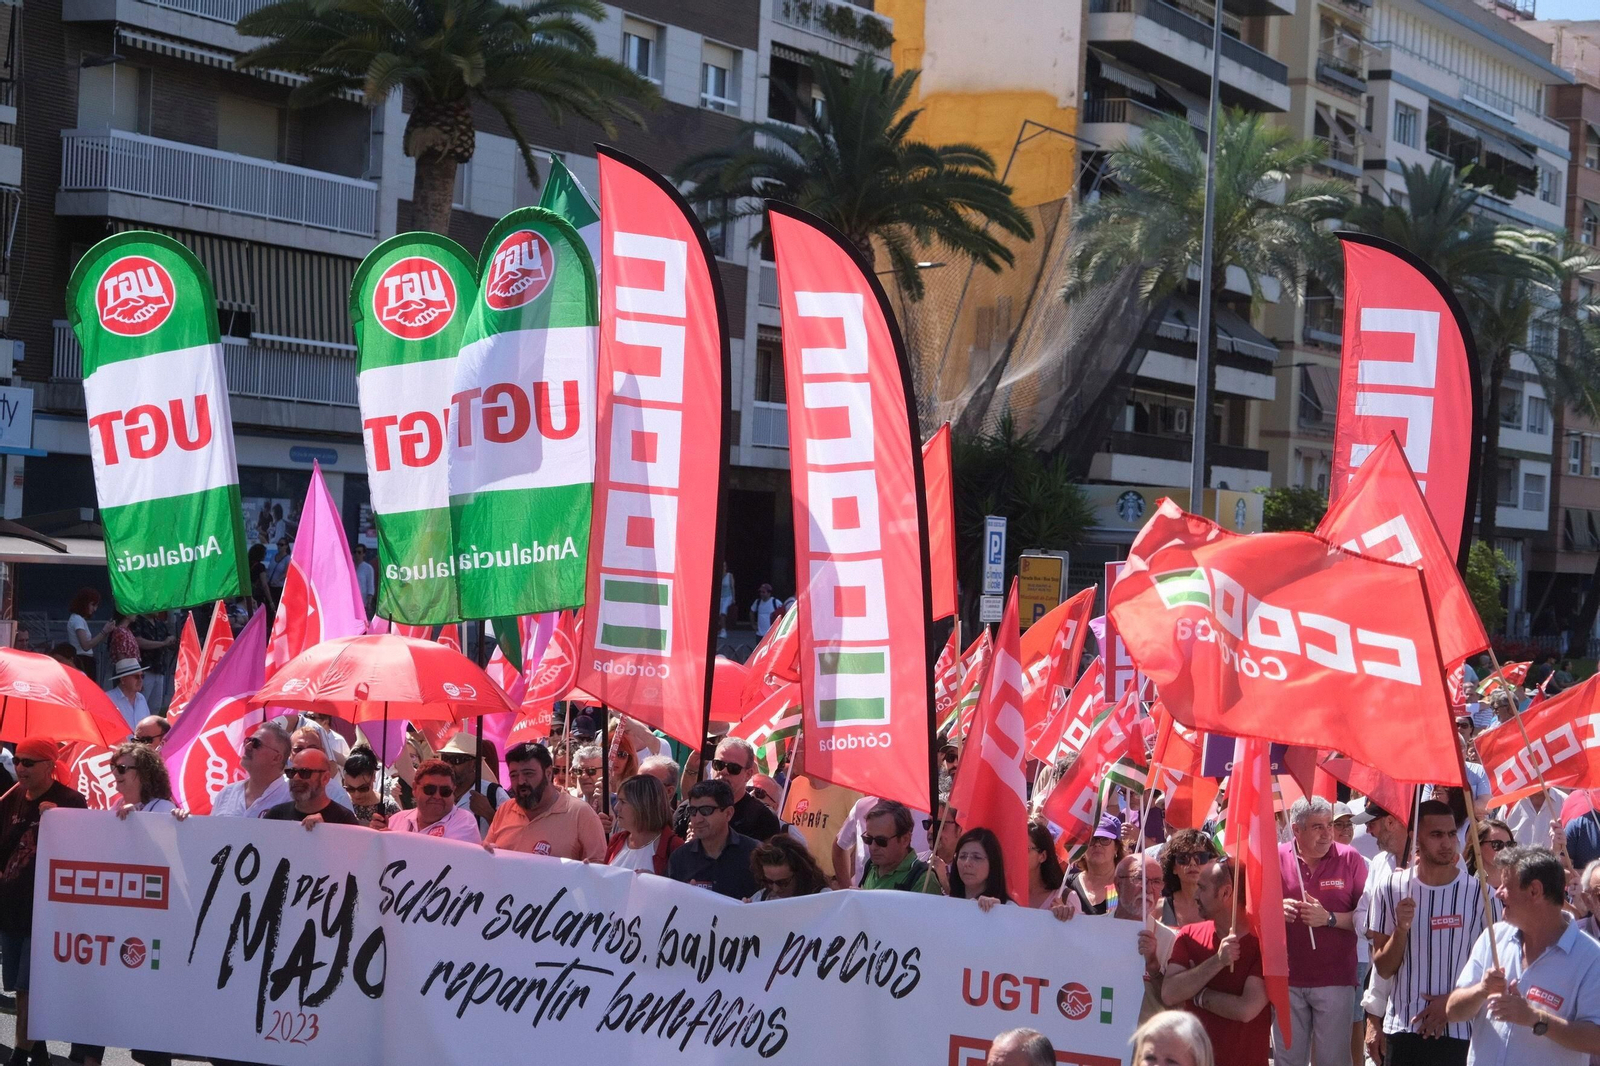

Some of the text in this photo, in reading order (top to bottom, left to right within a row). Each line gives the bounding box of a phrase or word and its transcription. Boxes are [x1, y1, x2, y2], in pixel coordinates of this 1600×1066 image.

[55, 868, 144, 899] CCOO
[290, 873, 325, 909] DE
[53, 931, 115, 966] UGT
[217, 856, 387, 1035] MAYO
[378, 859, 485, 929] Subir
[657, 906, 760, 985] bajar
[764, 930, 922, 1000] precios
[420, 957, 790, 1058] repartir beneficios
[962, 967, 1049, 1015] UGT
[264, 1009, 320, 1045] 2023
